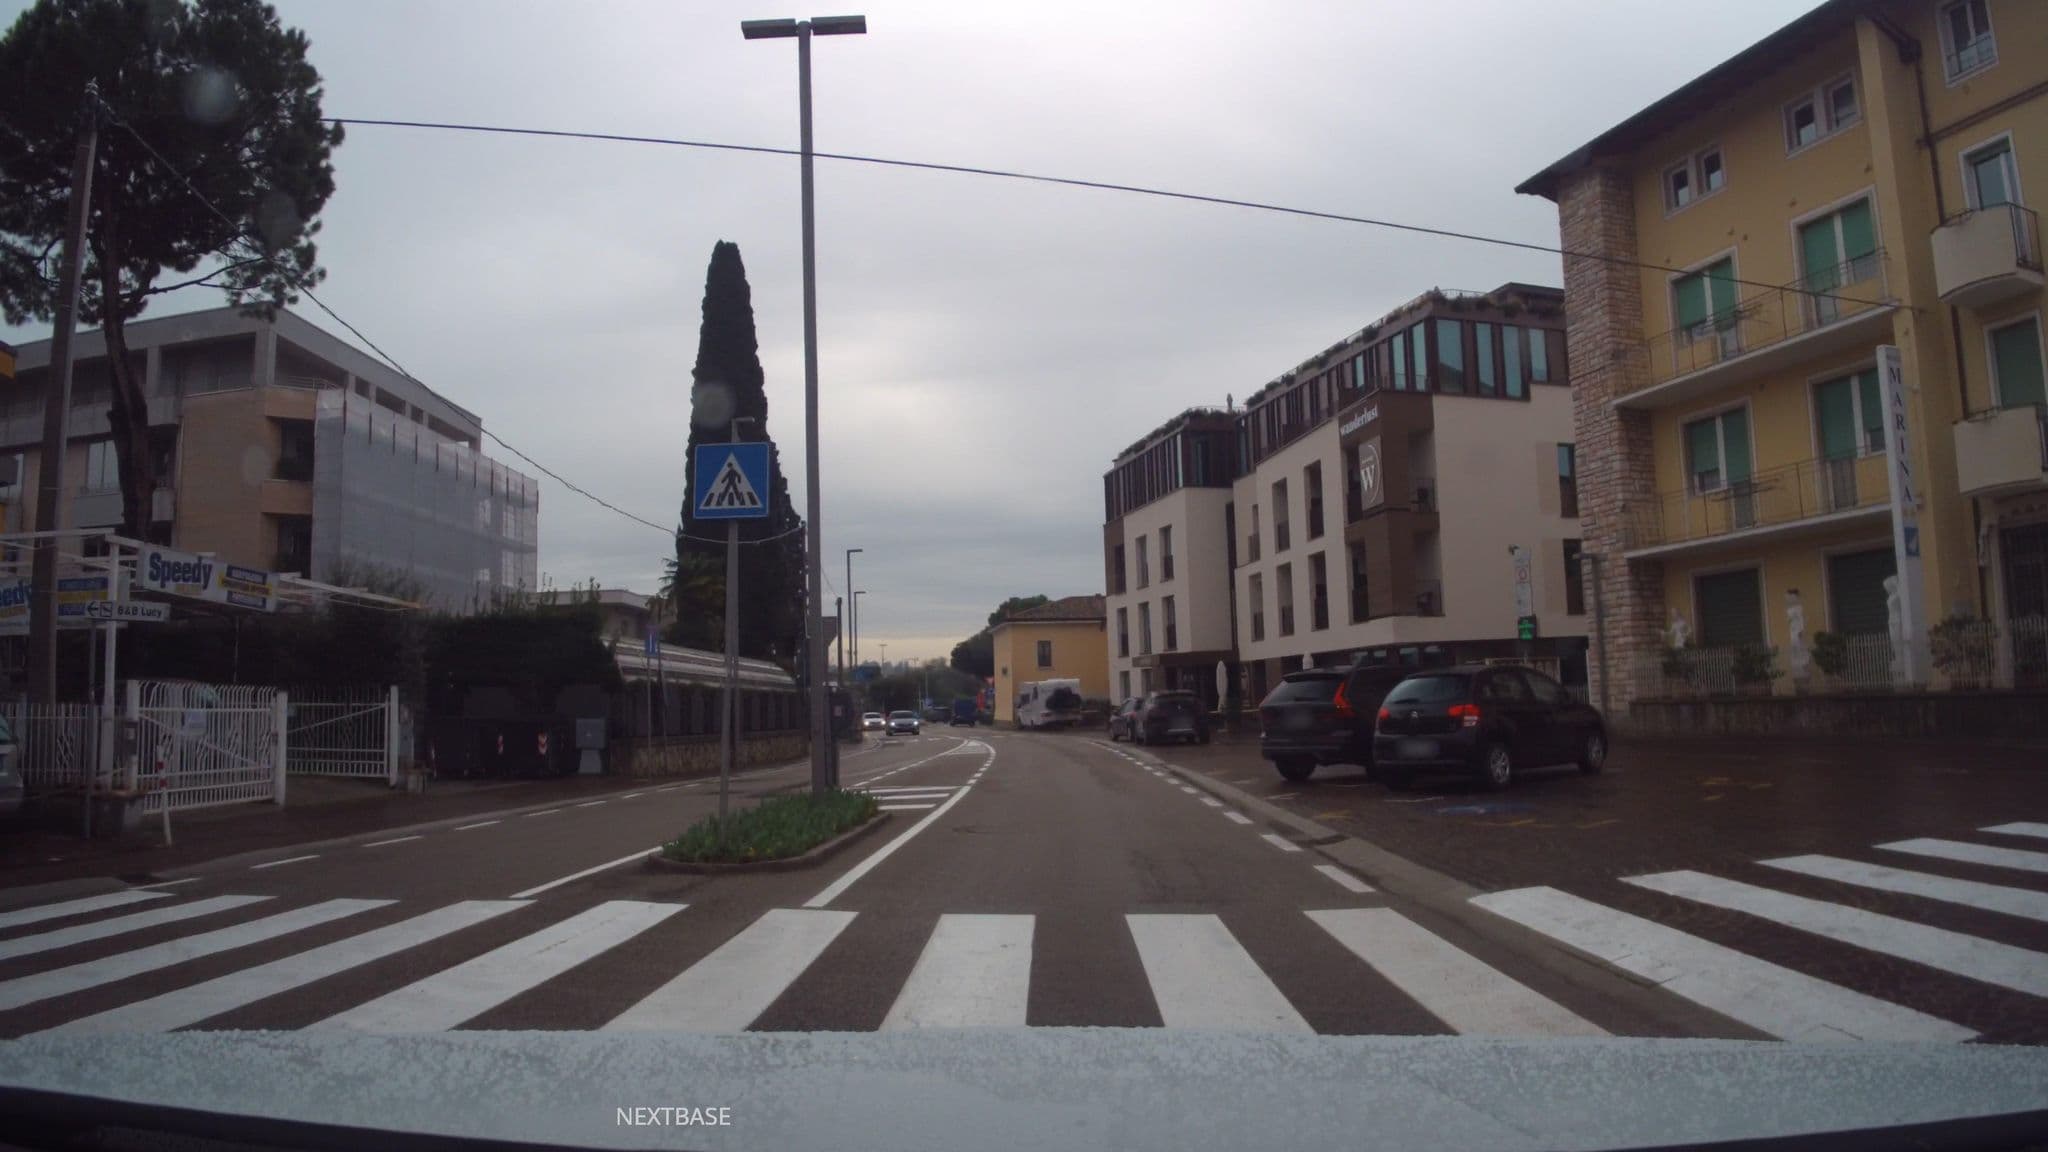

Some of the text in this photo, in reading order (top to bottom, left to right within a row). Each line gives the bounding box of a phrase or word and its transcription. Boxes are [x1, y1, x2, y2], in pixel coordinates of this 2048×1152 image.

[1340, 405, 1378, 435] wanderlust
[1889, 367, 1912, 502] MARINA
[1361, 466, 1375, 492] W
[149, 552, 212, 590] Speedy
[141, 606, 162, 618] Lucy
